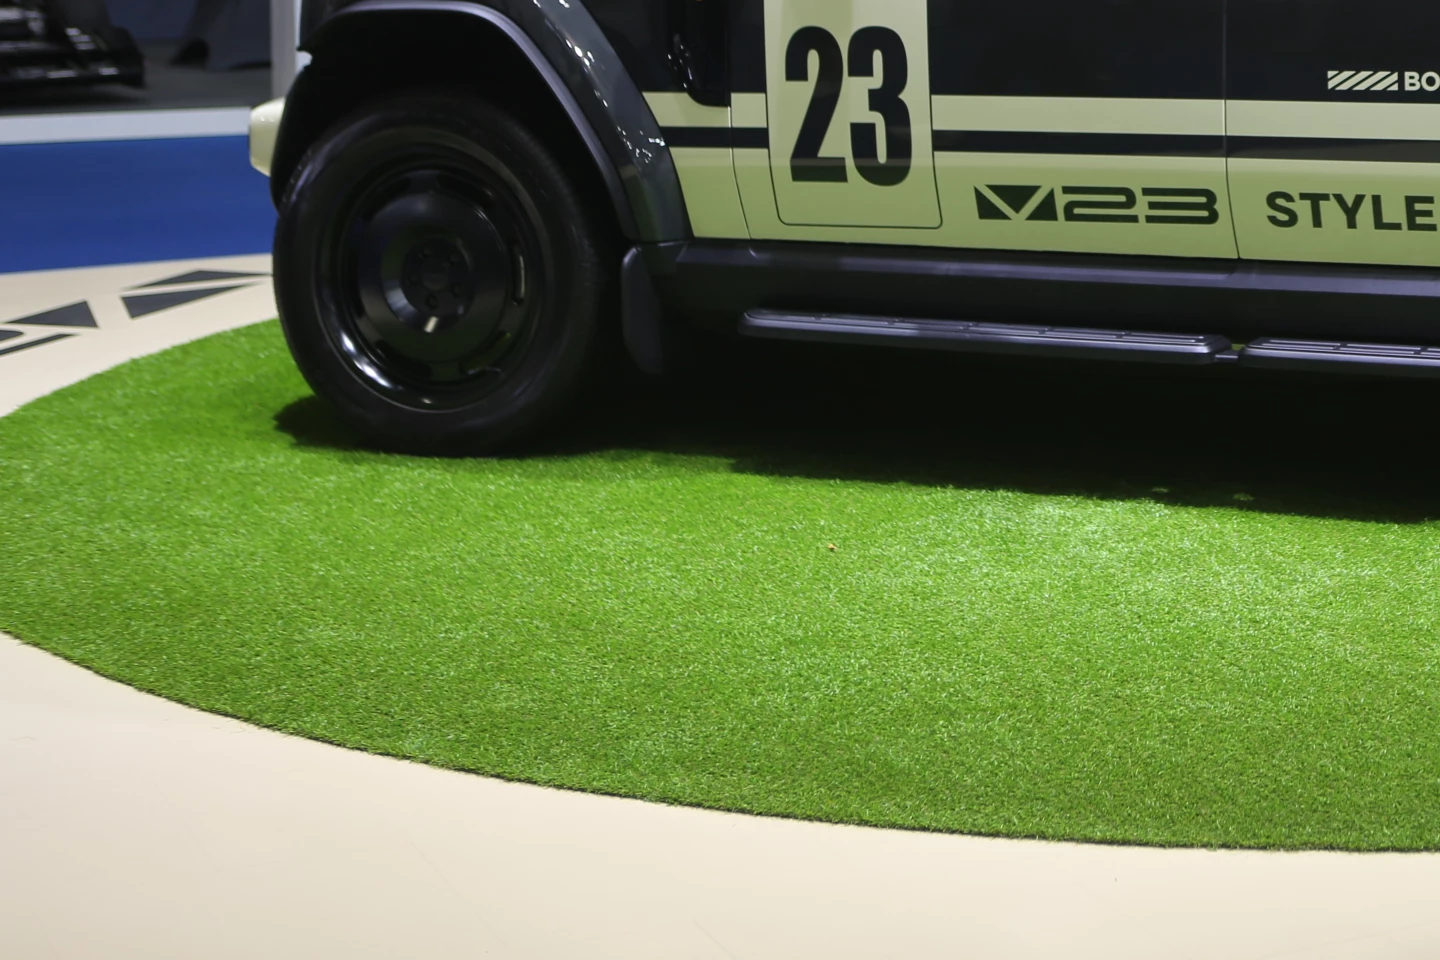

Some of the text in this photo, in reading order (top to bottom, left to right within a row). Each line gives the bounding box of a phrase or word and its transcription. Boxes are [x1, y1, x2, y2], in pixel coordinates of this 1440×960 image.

[785, 25, 912, 187] 23
[973, 184, 1438, 232] V23 STYLE
